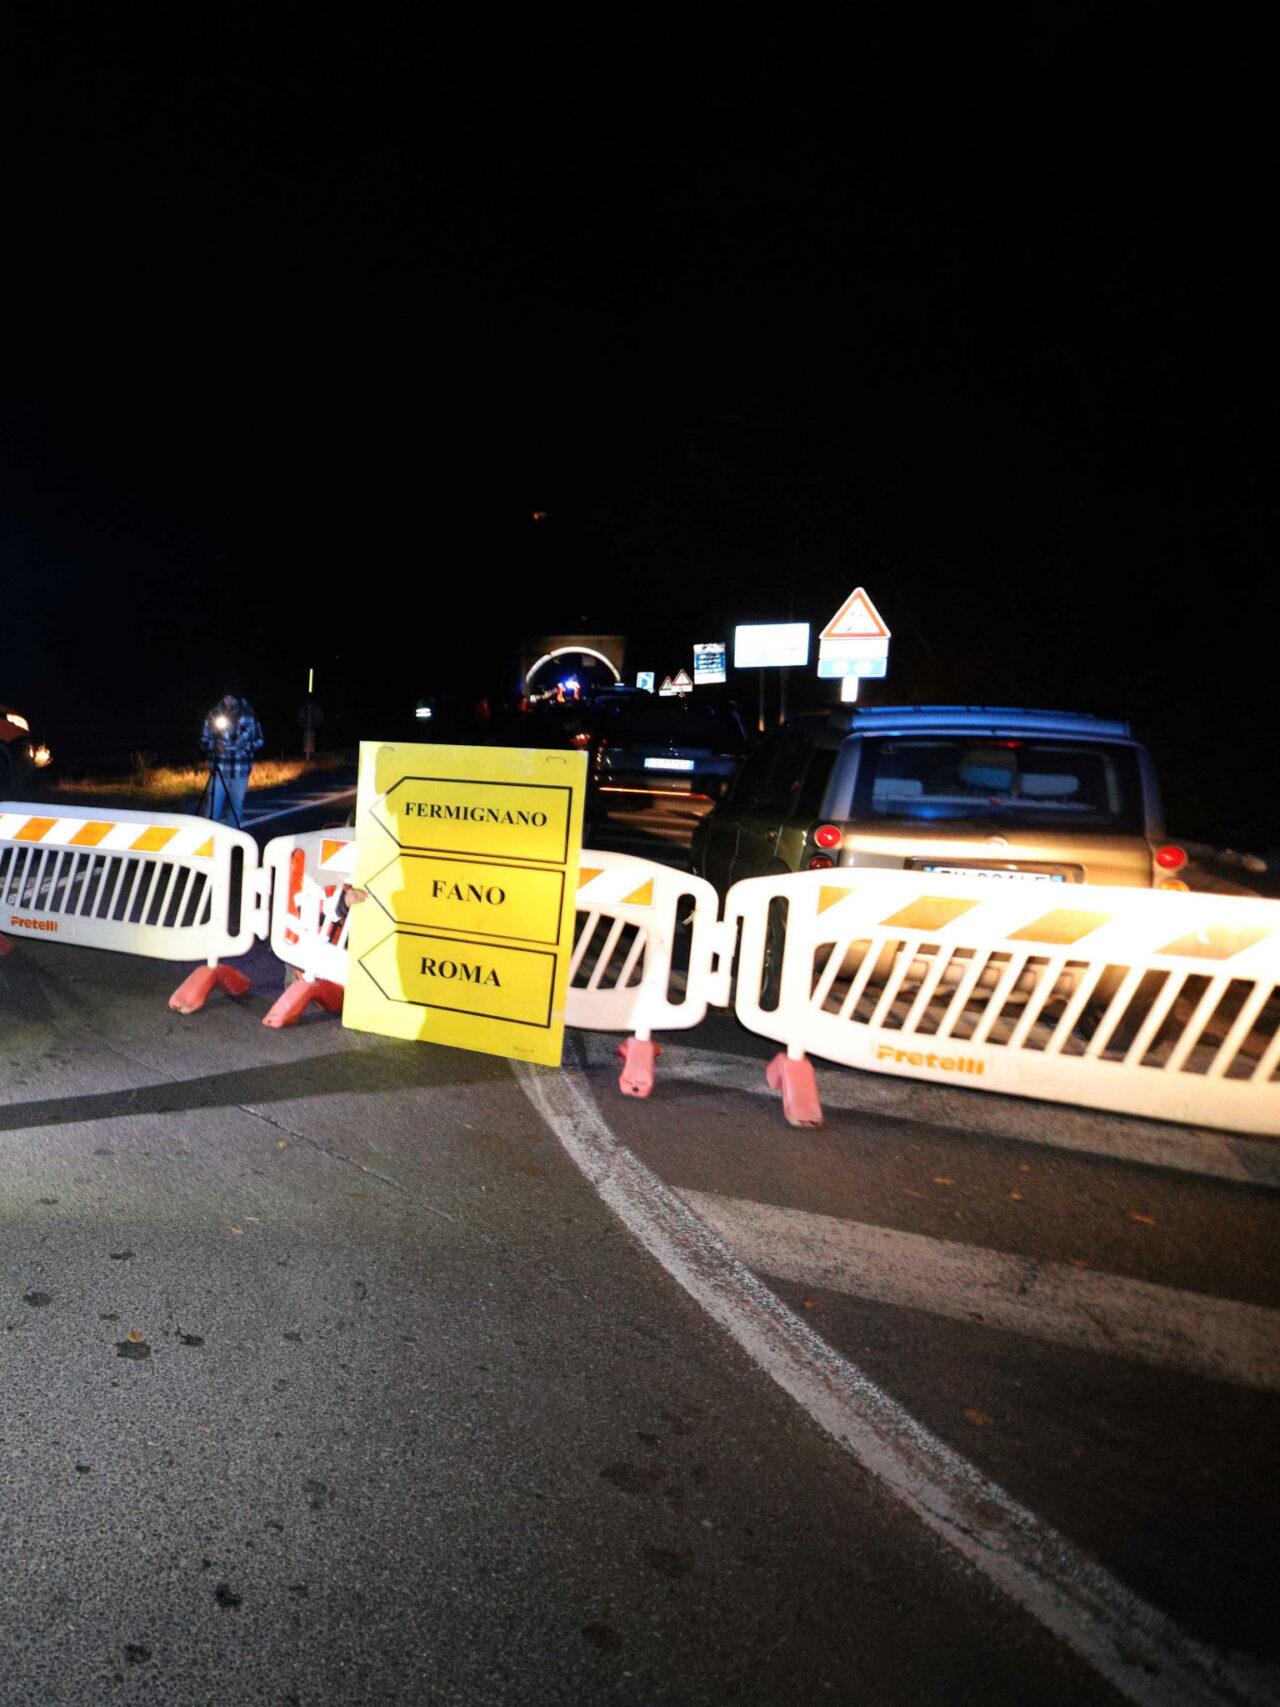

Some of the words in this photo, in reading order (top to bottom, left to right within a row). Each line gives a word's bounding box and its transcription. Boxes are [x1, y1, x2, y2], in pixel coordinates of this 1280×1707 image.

[405, 801, 548, 828] FERMIGNANO
[432, 879, 506, 906] FANO
[11, 915, 58, 932] Pretelli
[420, 956, 502, 988] ROMA
[876, 1044, 985, 1075] Pretelli
